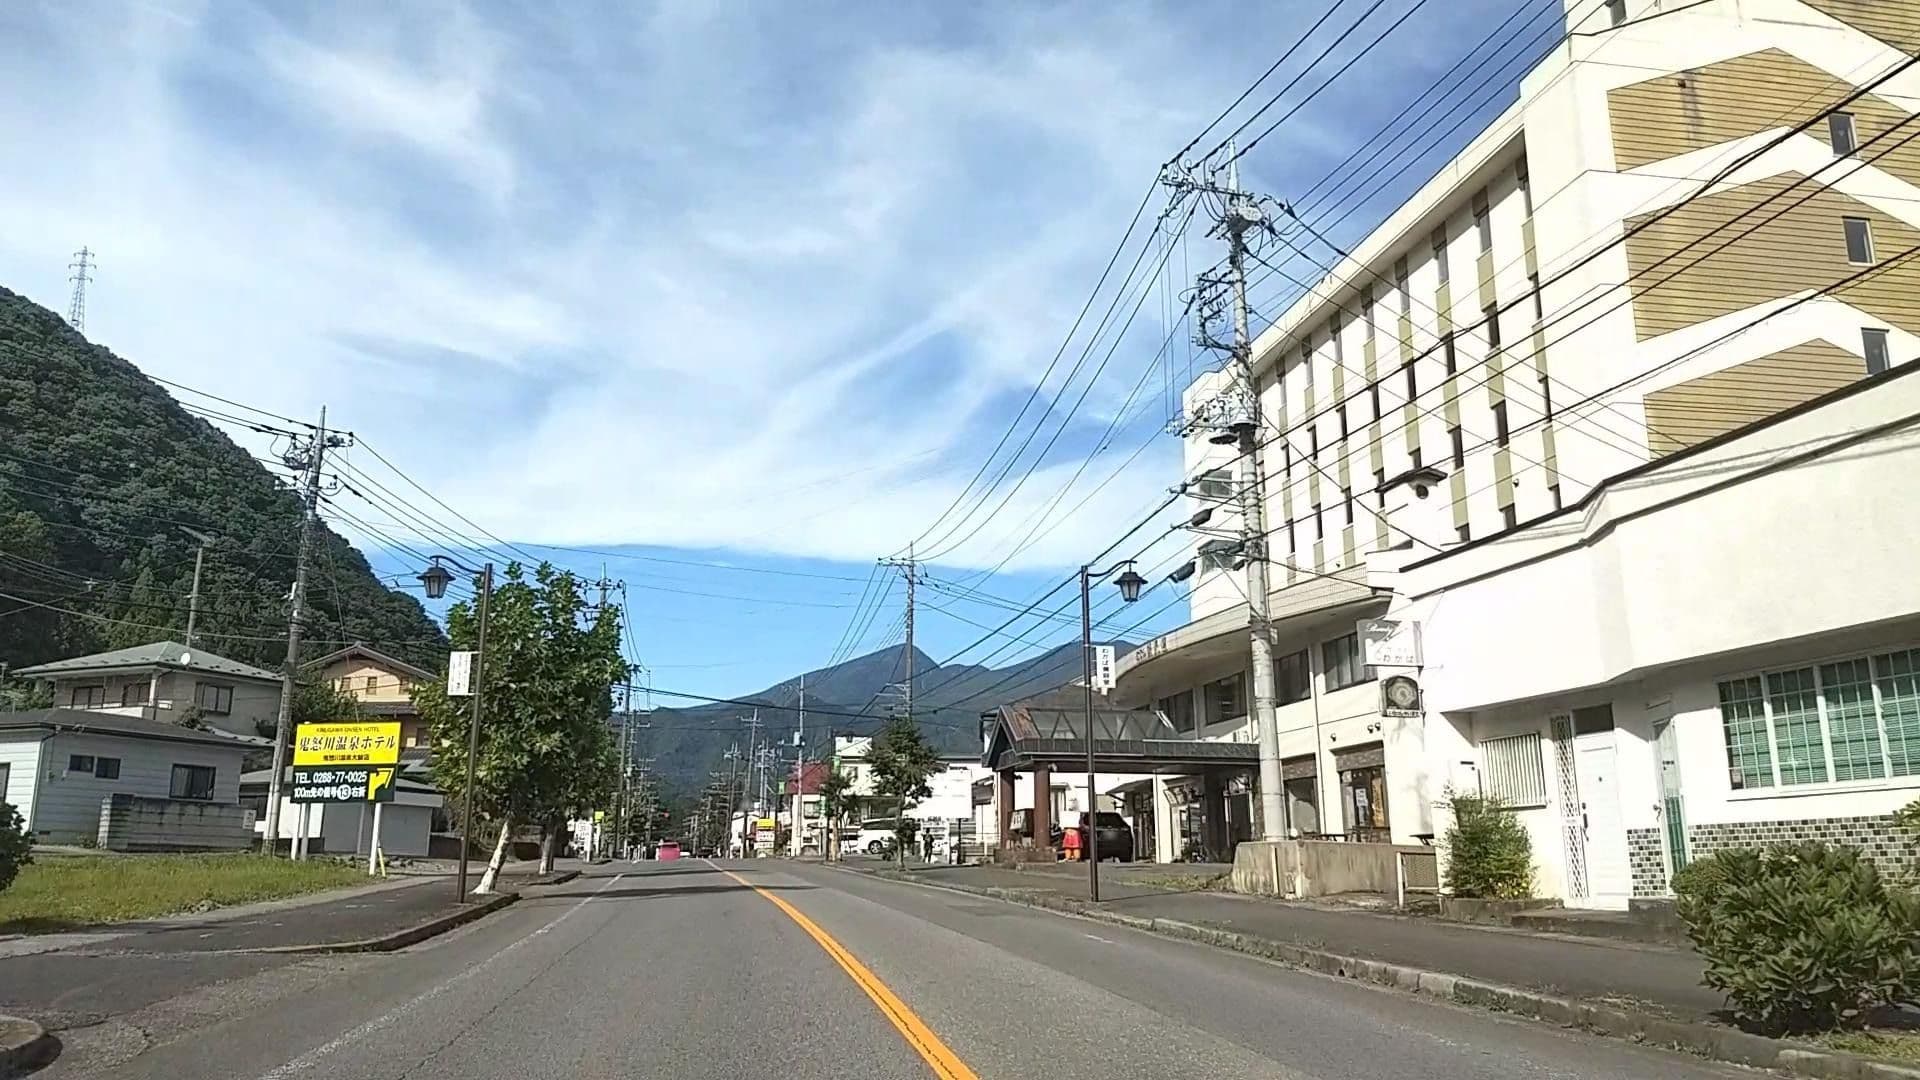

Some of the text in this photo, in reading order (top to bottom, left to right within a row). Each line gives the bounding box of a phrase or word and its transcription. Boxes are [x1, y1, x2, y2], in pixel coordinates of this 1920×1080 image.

[300, 735, 395, 752] 鬼怒川温泉ホテル
[294, 772, 311, 784] TEL
